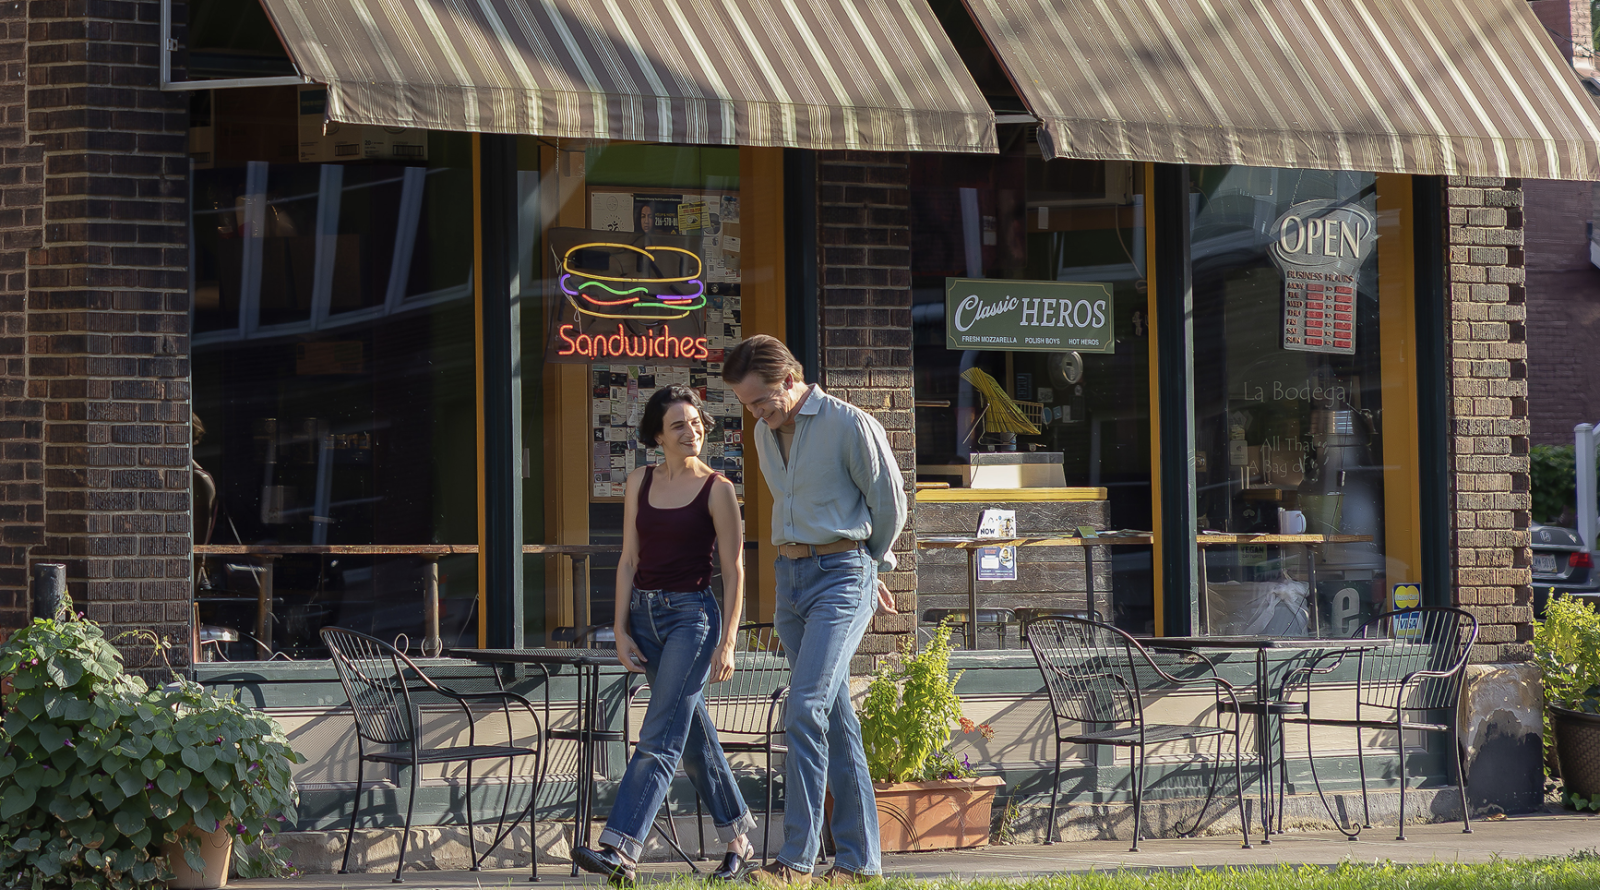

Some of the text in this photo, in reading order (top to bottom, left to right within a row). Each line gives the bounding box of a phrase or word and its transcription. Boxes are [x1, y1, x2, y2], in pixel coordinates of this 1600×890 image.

[1280, 215, 1360, 258] OPEN
[1286, 270, 1354, 283] BUSINESS HOURS
[954, 294, 1106, 332] Classic HEROS
[1287, 300, 1303, 308] WED
[558, 324, 708, 359] Sandwiches
[981, 336, 1017, 344] MOZZARELLA
[1244, 379, 1346, 408] La Bodega
[1260, 435, 1316, 452] All That
[1249, 460, 1259, 473] A
[1263, 460, 1287, 478] Bag
